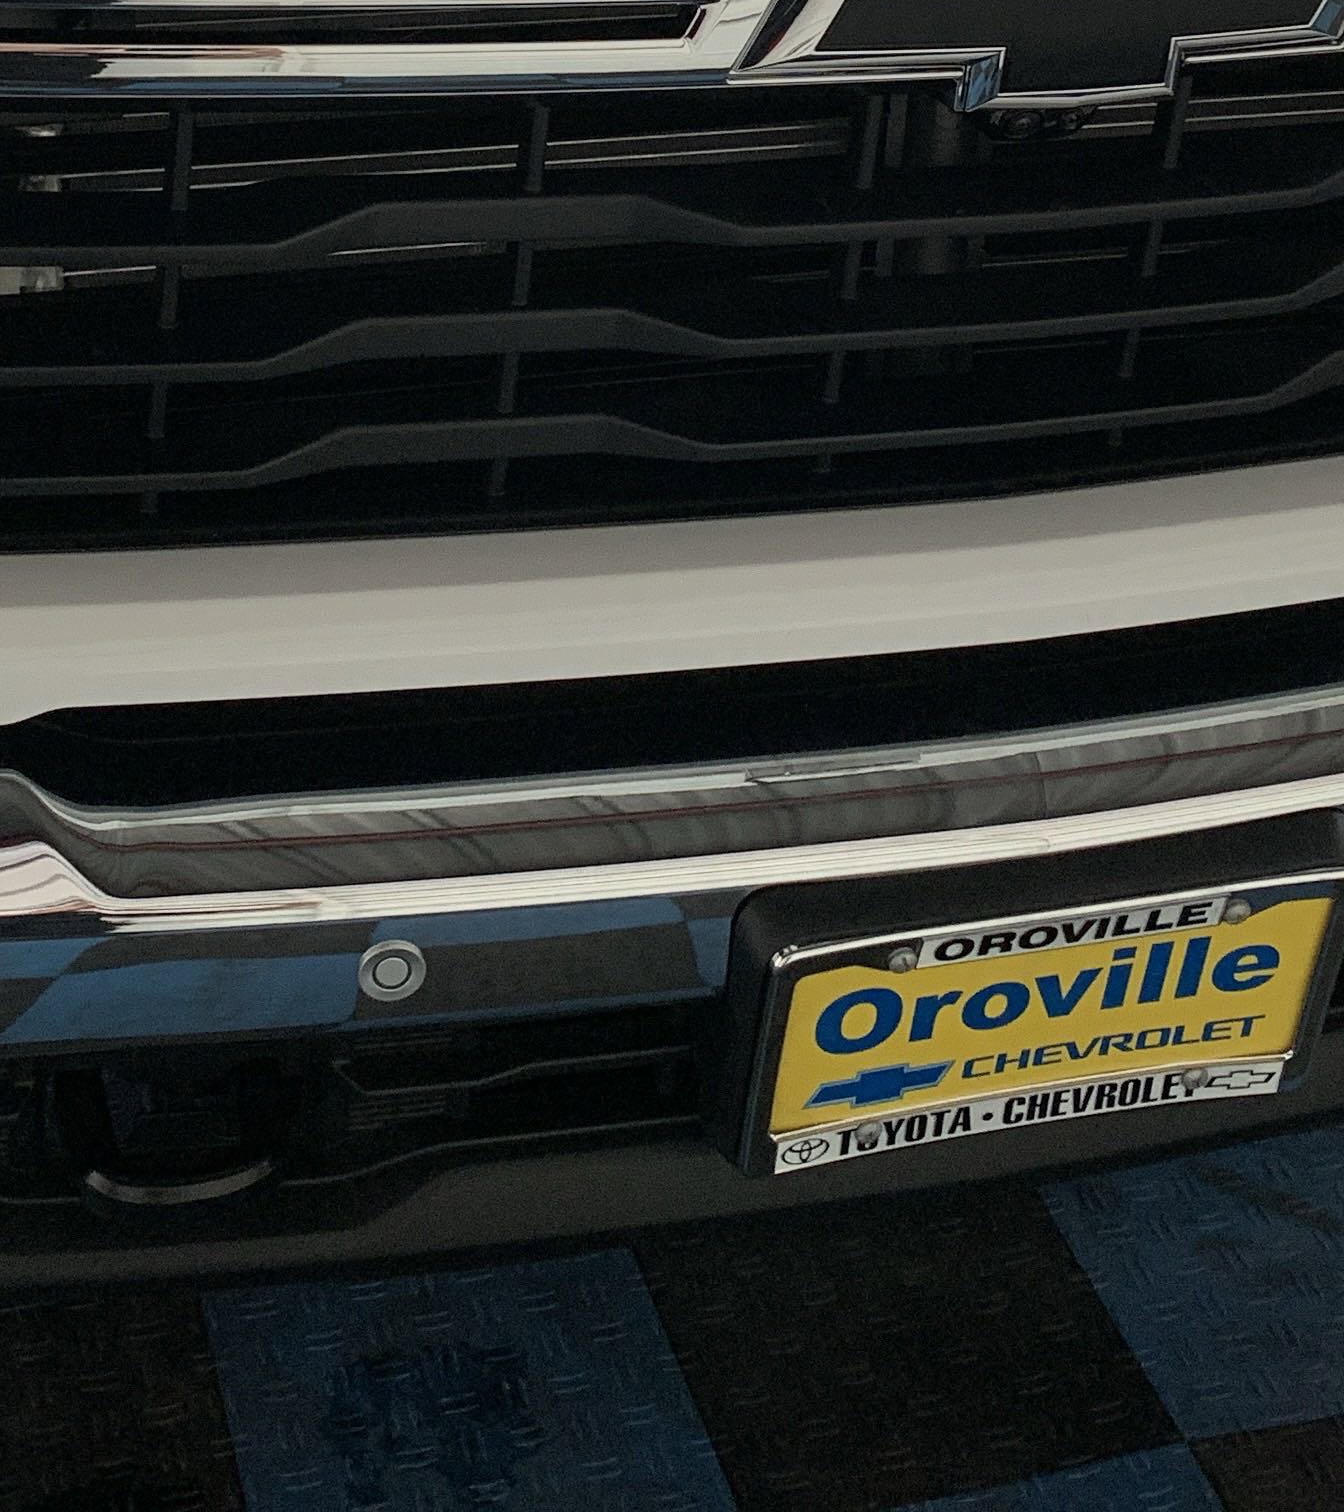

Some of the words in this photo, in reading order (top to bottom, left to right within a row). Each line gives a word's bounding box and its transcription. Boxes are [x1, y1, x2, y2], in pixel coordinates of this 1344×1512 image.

[934, 902, 1211, 962] OROVILLE
[815, 937, 1280, 1055] Oroville
[961, 1016, 1265, 1079] CHEVROLET
[837, 1107, 972, 1157] TYOTA
